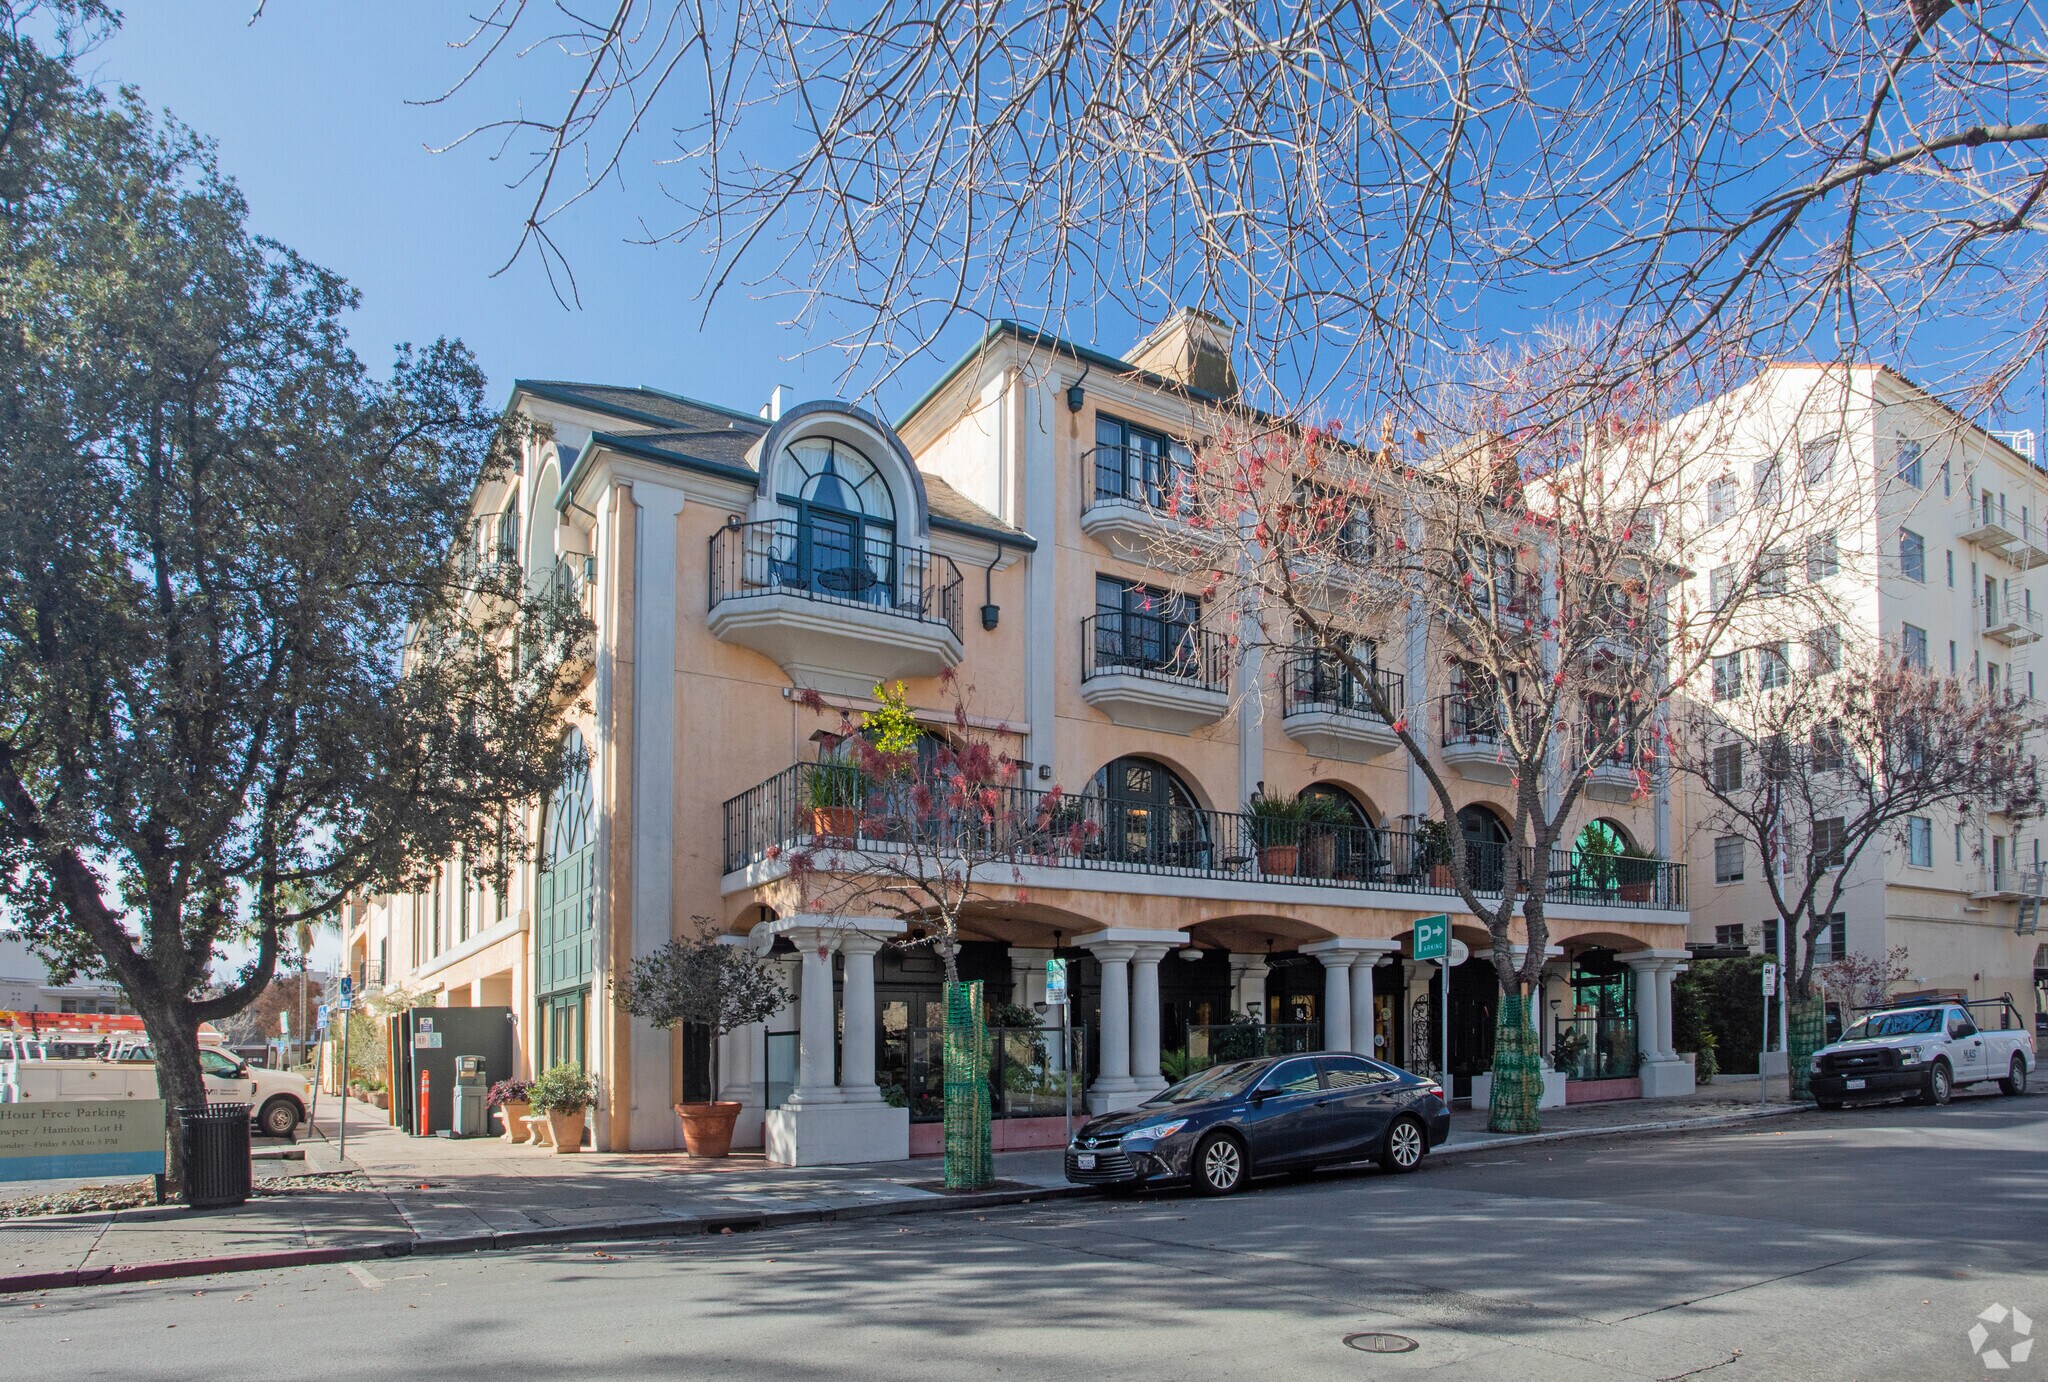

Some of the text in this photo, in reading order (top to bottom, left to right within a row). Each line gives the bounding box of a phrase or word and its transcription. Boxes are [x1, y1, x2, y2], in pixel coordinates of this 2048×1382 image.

[1, 1107, 126, 1120] Hour Free Parking
[43, 1125, 90, 1134] Hamilton
[93, 1124, 111, 1132] Lot
[114, 1124, 123, 1132] H
[34, 1141, 58, 1149] Friday
